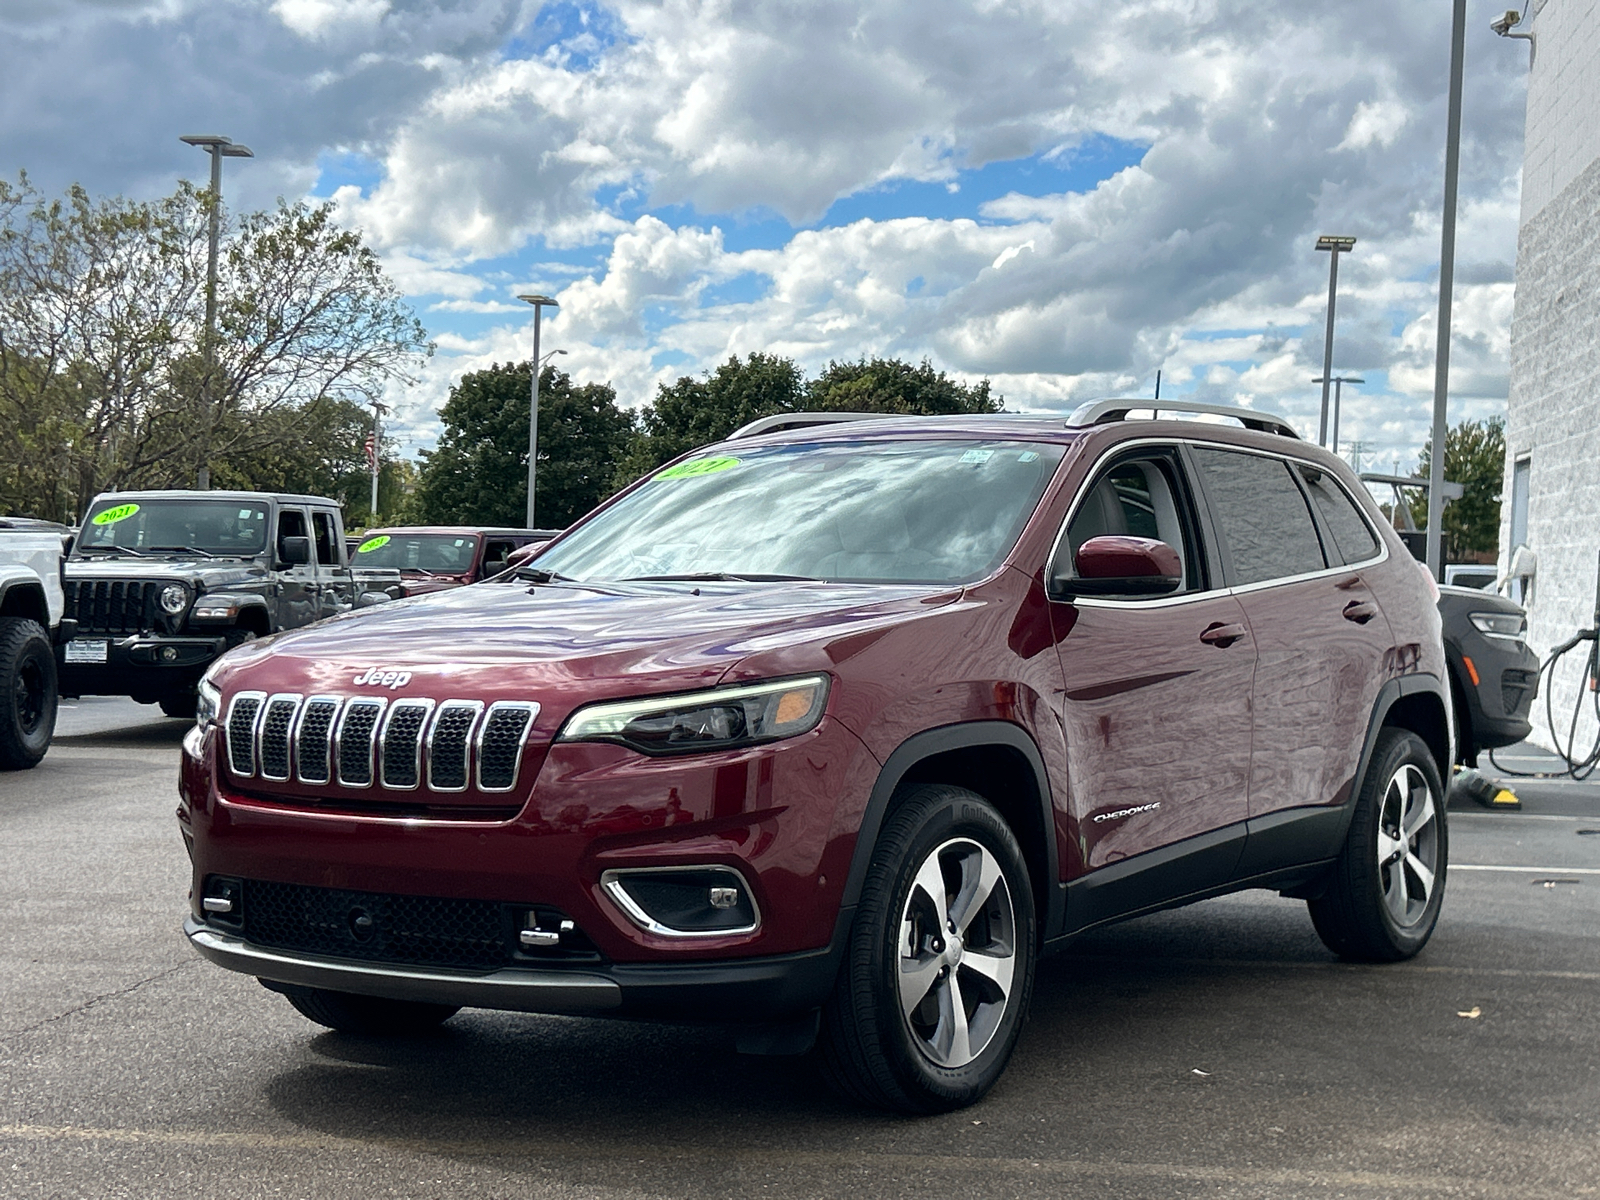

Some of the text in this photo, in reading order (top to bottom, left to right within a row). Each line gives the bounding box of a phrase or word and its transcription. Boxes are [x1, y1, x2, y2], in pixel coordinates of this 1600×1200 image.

[101, 506, 131, 523] 2021
[353, 667, 412, 690] Jeep
[1093, 801, 1161, 823] CHEROKEE
